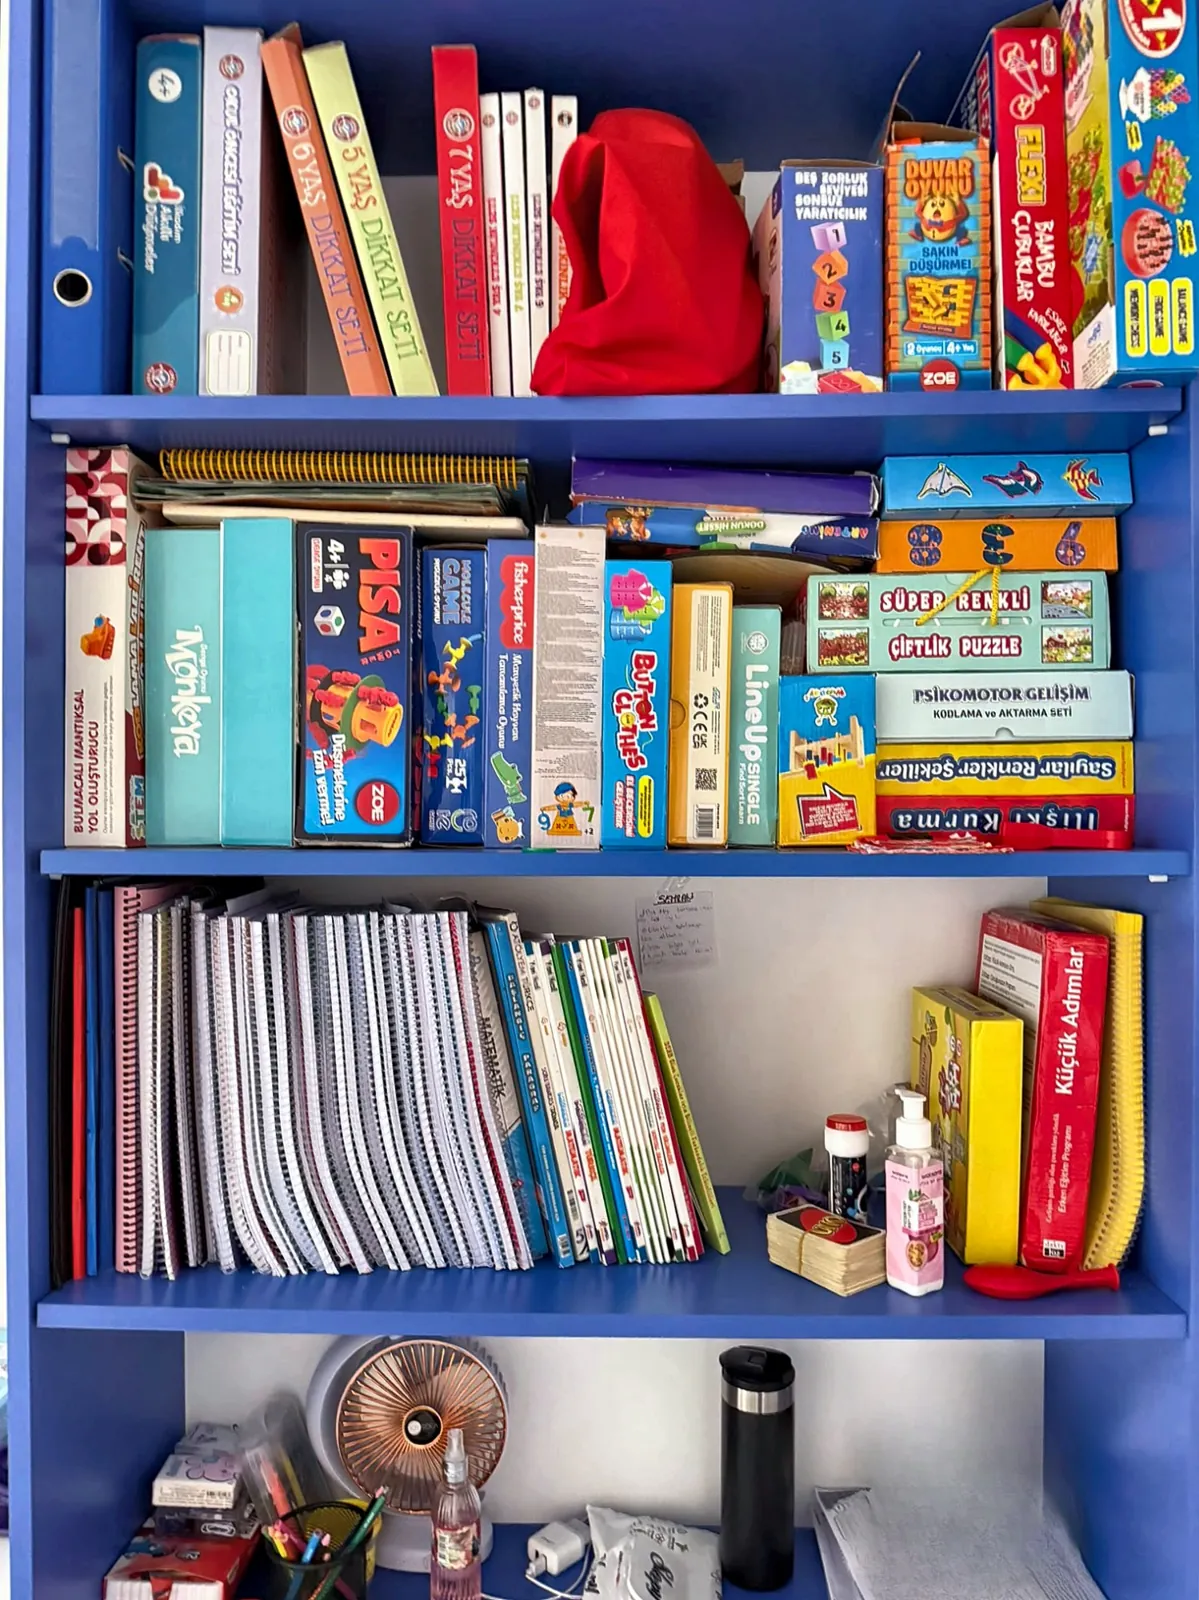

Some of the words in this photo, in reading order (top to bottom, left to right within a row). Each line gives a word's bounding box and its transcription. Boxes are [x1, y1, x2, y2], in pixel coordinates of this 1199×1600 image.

[292, 141, 312, 161] 6
[342, 146, 366, 163] 5
[448, 145, 473, 163] 7
[795, 171, 817, 187] BEŞ
[821, 171, 868, 186] ZORLUK
[905, 158, 976, 180] DUVAR
[297, 159, 326, 207] YAŞ
[347, 163, 377, 211] YAŞ
[446, 164, 473, 208] YAŞ
[904, 177, 975, 199] OYUNU
[795, 207, 868, 221] YARATICILIK
[832, 228, 841, 243] 1
[310, 214, 354, 299] DİKKAT
[361, 218, 405, 303] DİKKAT
[452, 218, 478, 304] DİKKAT
[922, 246, 959, 258] SAKIN
[1011, 210, 1034, 302] ÇUBUKLAR
[1035, 219, 1056, 289] BAMBU
[822, 262, 838, 279] 2
[909, 257, 972, 273] DÜŞÜRME!
[823, 291, 837, 308] 3
[335, 306, 371, 357] SETİ
[386, 310, 423, 360] SETİ
[456, 311, 484, 361] SETİ
[835, 319, 847, 333] 4
[831, 351, 842, 365] 5
[946, 341, 961, 354] 4+
[923, 372, 958, 386] ZOE
[731, 520, 766, 533] DOKUN
[327, 538, 345, 563] 4+
[907, 523, 943, 567] 8
[359, 538, 401, 653] PISA
[442, 558, 460, 625] GAME
[880, 586, 944, 612] SÜPER
[956, 585, 1030, 612] RENKLİ
[889, 633, 950, 661] ÇİFTLİK
[960, 635, 1022, 657] PUZZLE
[914, 685, 1023, 703] PSİKOMOTOR
[1025, 684, 1091, 703] GELİŞİM
[74, 688, 85, 760] MANTIKSAL
[739, 664, 770, 761] LineUp
[933, 708, 983, 719] KODLAMA
[984, 710, 996, 719] ve
[998, 708, 1048, 719] AKTARMA
[1050, 706, 1073, 719] SETİ
[88, 721, 101, 805] OLUŞTURUCU
[453, 759, 467, 776] 25
[879, 757, 955, 779] Şekiller
[957, 761, 1037, 778] Renkler
[1040, 758, 1114, 778] Sayılar
[332, 734, 349, 821] Düşmelerine
[74, 762, 84, 833] BULMACALI
[371, 784, 385, 821] ZOE
[747, 762, 761, 825] SINGLE
[88, 811, 98, 834] YOL
[538, 813, 551, 831] 9
[582, 806, 595, 822] 7
[897, 812, 1000, 833] Kurma
[1061, 947, 1085, 1027] Adımlar
[482, 1017, 506, 1100] MATEMATİK
[1055, 1032, 1078, 1095] Küçük
[574, 1229, 586, 1245] 5
